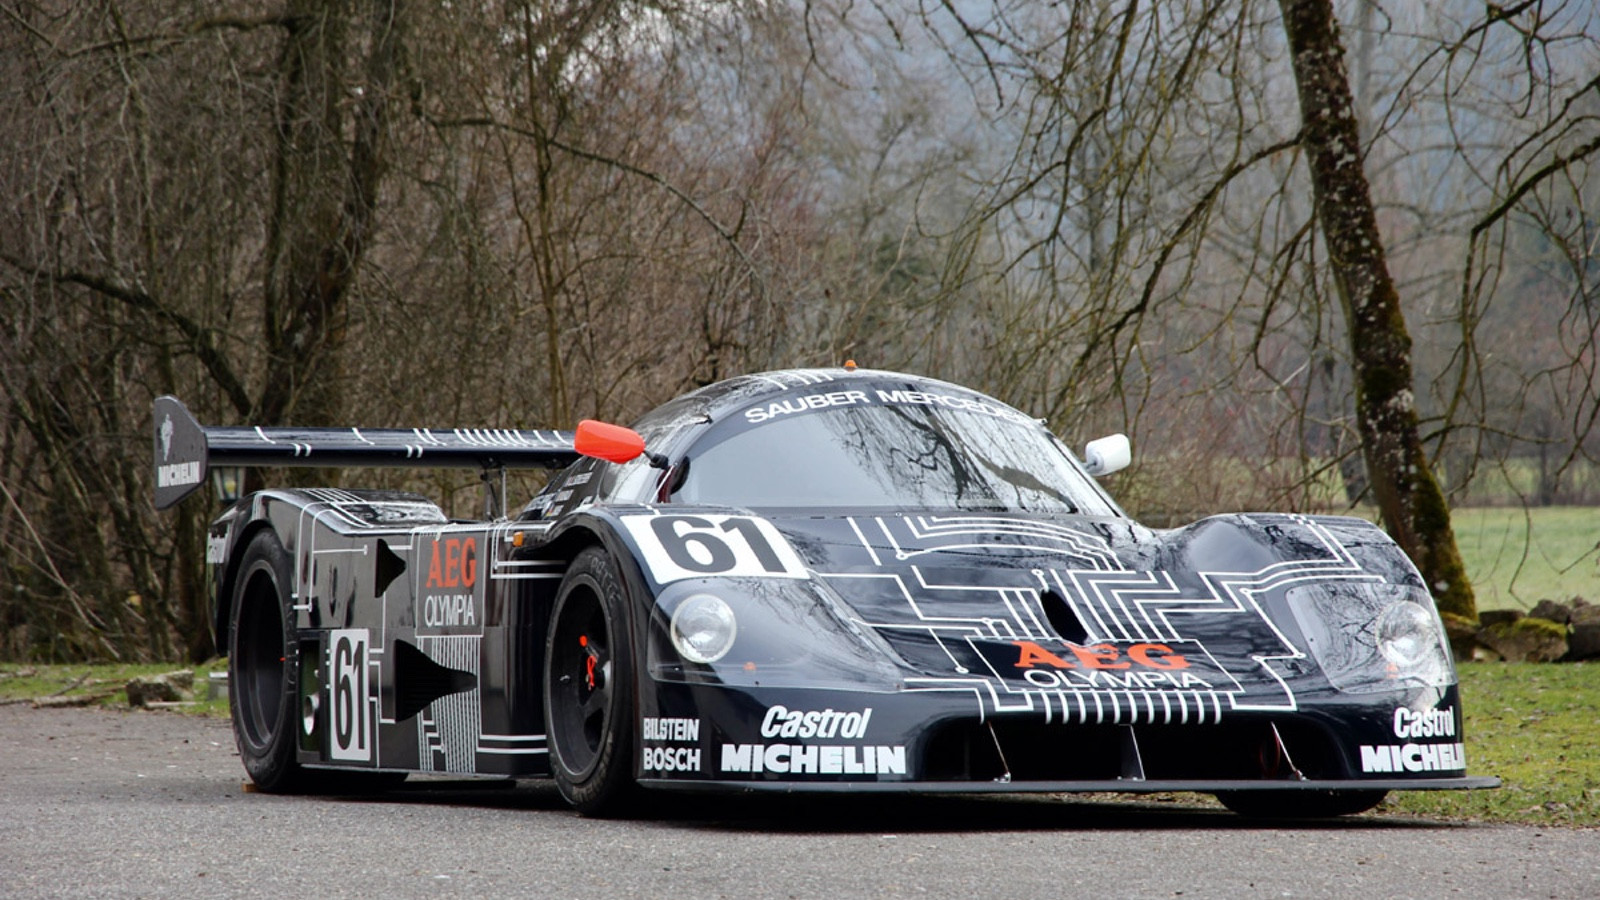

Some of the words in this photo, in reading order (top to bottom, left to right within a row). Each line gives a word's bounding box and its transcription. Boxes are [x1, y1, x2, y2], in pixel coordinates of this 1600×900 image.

[744, 389, 870, 424] SAUBER
[874, 389, 1034, 429] MERCEDE
[650, 515, 787, 573] 61
[426, 537, 477, 588] AEG
[424, 594, 475, 628] OLYMPIA
[1012, 640, 1190, 670] AEG
[335, 636, 366, 751] 61
[1024, 669, 1213, 688] OLYMPIA
[643, 718, 700, 741] BILSTEIN
[761, 705, 872, 739] Castrol
[1394, 705, 1455, 739] Castrol
[643, 747, 701, 771] BOSCH
[721, 743, 906, 775] MICHELIN
